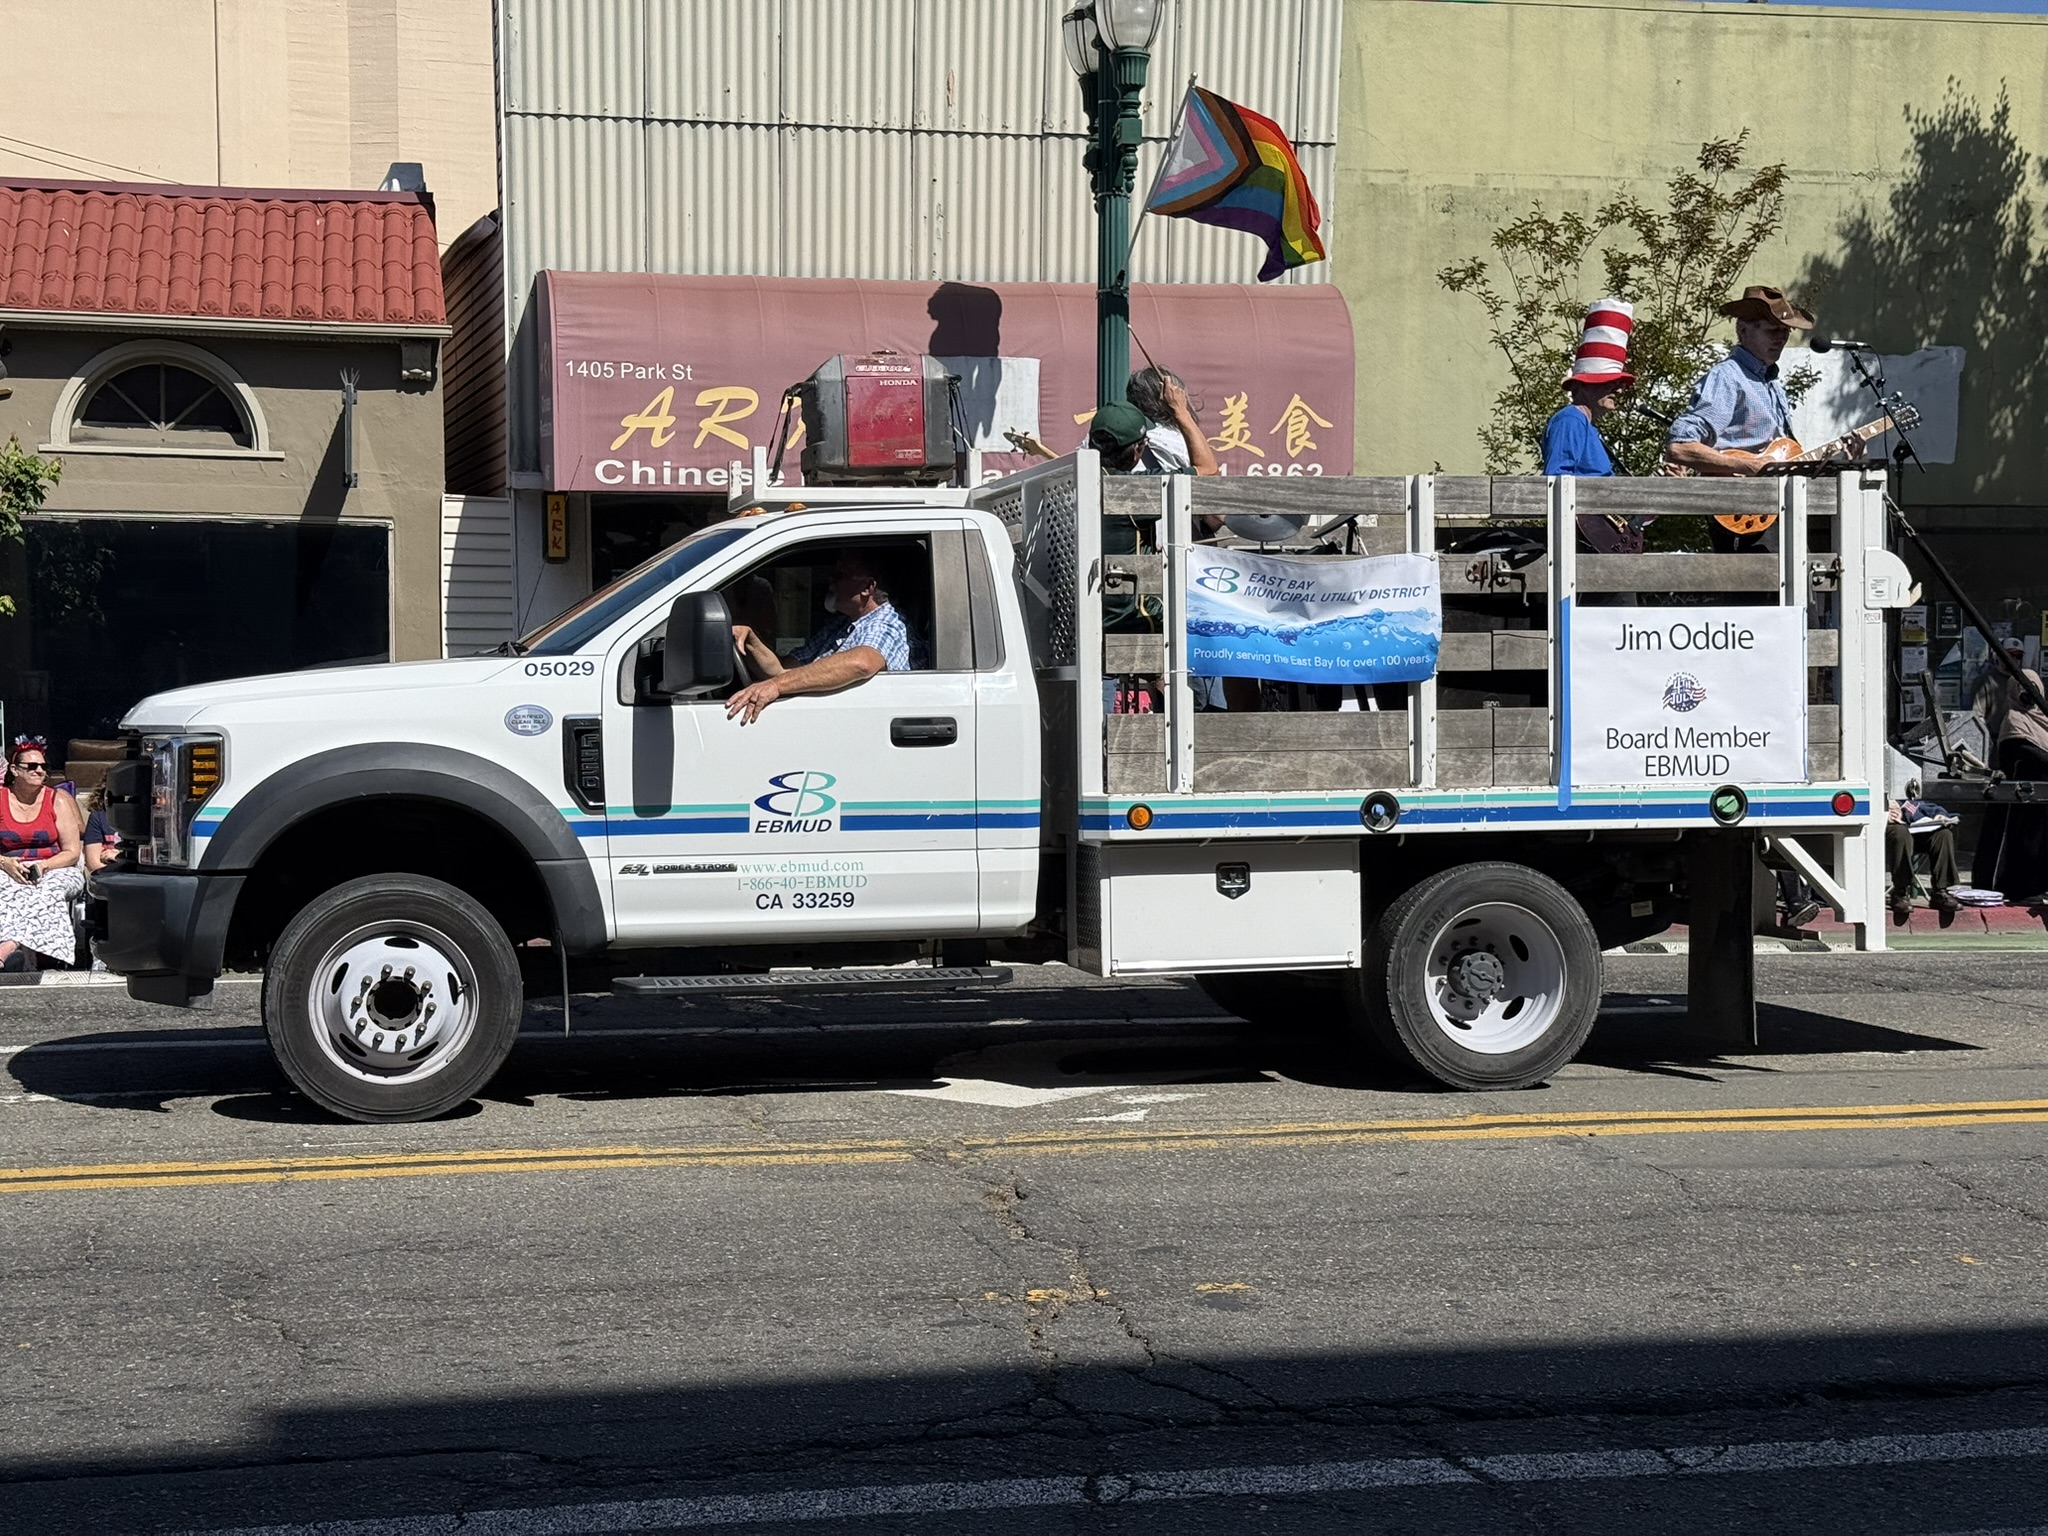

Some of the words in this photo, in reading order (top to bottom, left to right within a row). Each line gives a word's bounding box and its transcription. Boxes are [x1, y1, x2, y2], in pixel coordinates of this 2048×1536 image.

[566, 360, 615, 378] 1405
[620, 362, 667, 380] Park
[671, 363, 693, 381] St
[879, 379, 918, 387] HONDA
[1207, 391, 1334, 459] 美食
[550, 500, 564, 549] ARK
[1248, 572, 1286, 589] EAST
[1287, 578, 1316, 591] BAY
[1243, 585, 1316, 603] MUNICIPAL
[1320, 589, 1367, 603] UTILITY
[1368, 585, 1431, 600] DISTRICT
[1615, 623, 1662, 651] Jim
[1668, 621, 1755, 651] Oddie
[1193, 648, 1234, 661] Proudly
[1236, 651, 1271, 664] serving
[1273, 653, 1289, 664] the
[1290, 655, 1312, 667] East
[1314, 656, 1334, 669] Bay
[1336, 655, 1351, 667] for
[1352, 658, 1378, 668] over
[1381, 655, 1401, 666] 100
[524, 661, 595, 677] 05029
[1606, 726, 1669, 750] Board
[1674, 725, 1771, 749] Member
[1644, 754, 1730, 777] EBMUD
[753, 819, 833, 834] EBMUD
[656, 864, 695, 872] POWER
[695, 863, 736, 871] STROKE
[740, 860, 864, 874] www.ebmud.com
[737, 875, 868, 891] 1-866-40-EBMUD
[755, 893, 784, 910] CA
[792, 892, 855, 909] 33259
